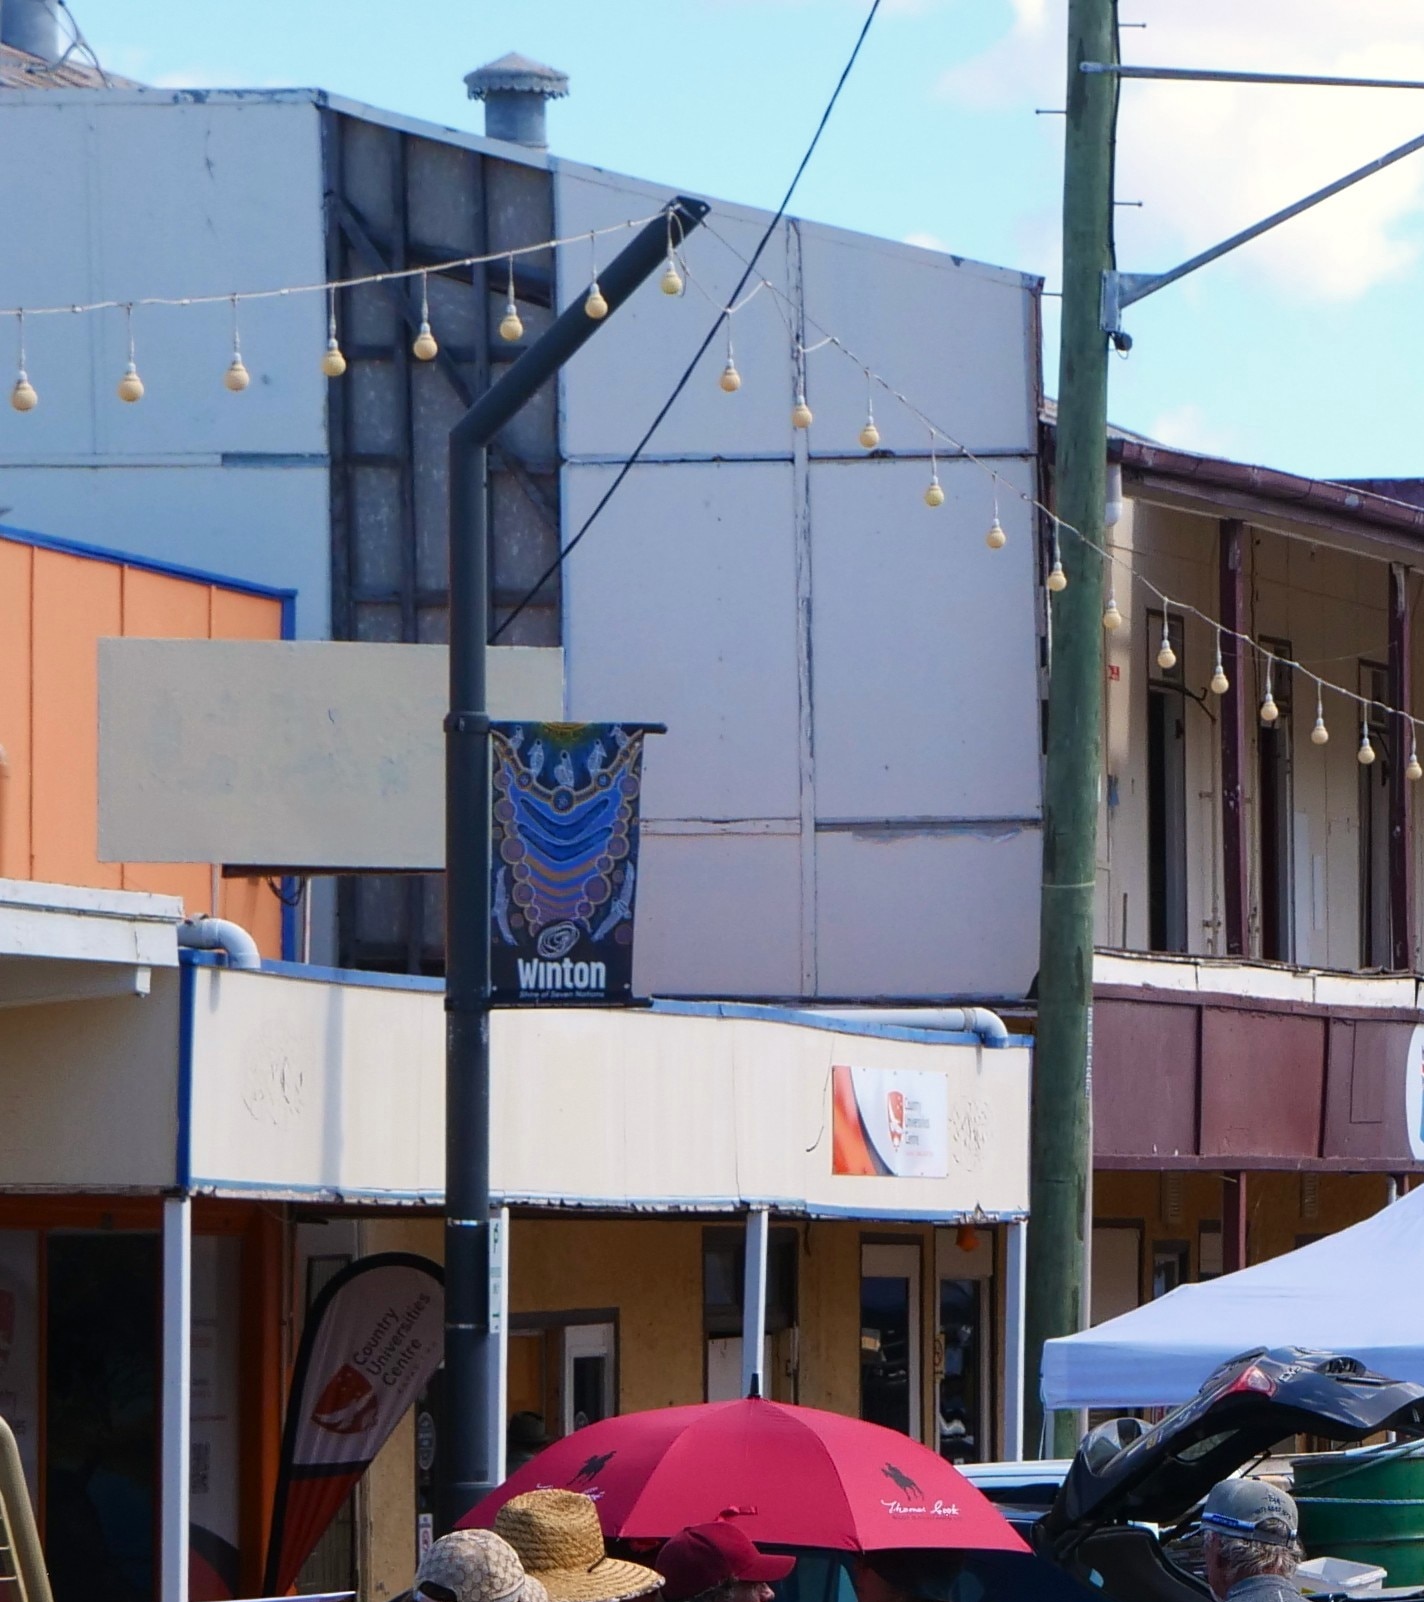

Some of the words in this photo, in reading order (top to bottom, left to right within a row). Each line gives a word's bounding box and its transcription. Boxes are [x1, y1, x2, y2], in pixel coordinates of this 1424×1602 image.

[517, 958, 606, 989] Winton
[353, 1307, 399, 1366] Country
[366, 1293, 431, 1376] Universities
[382, 1339, 422, 1386] Centre
